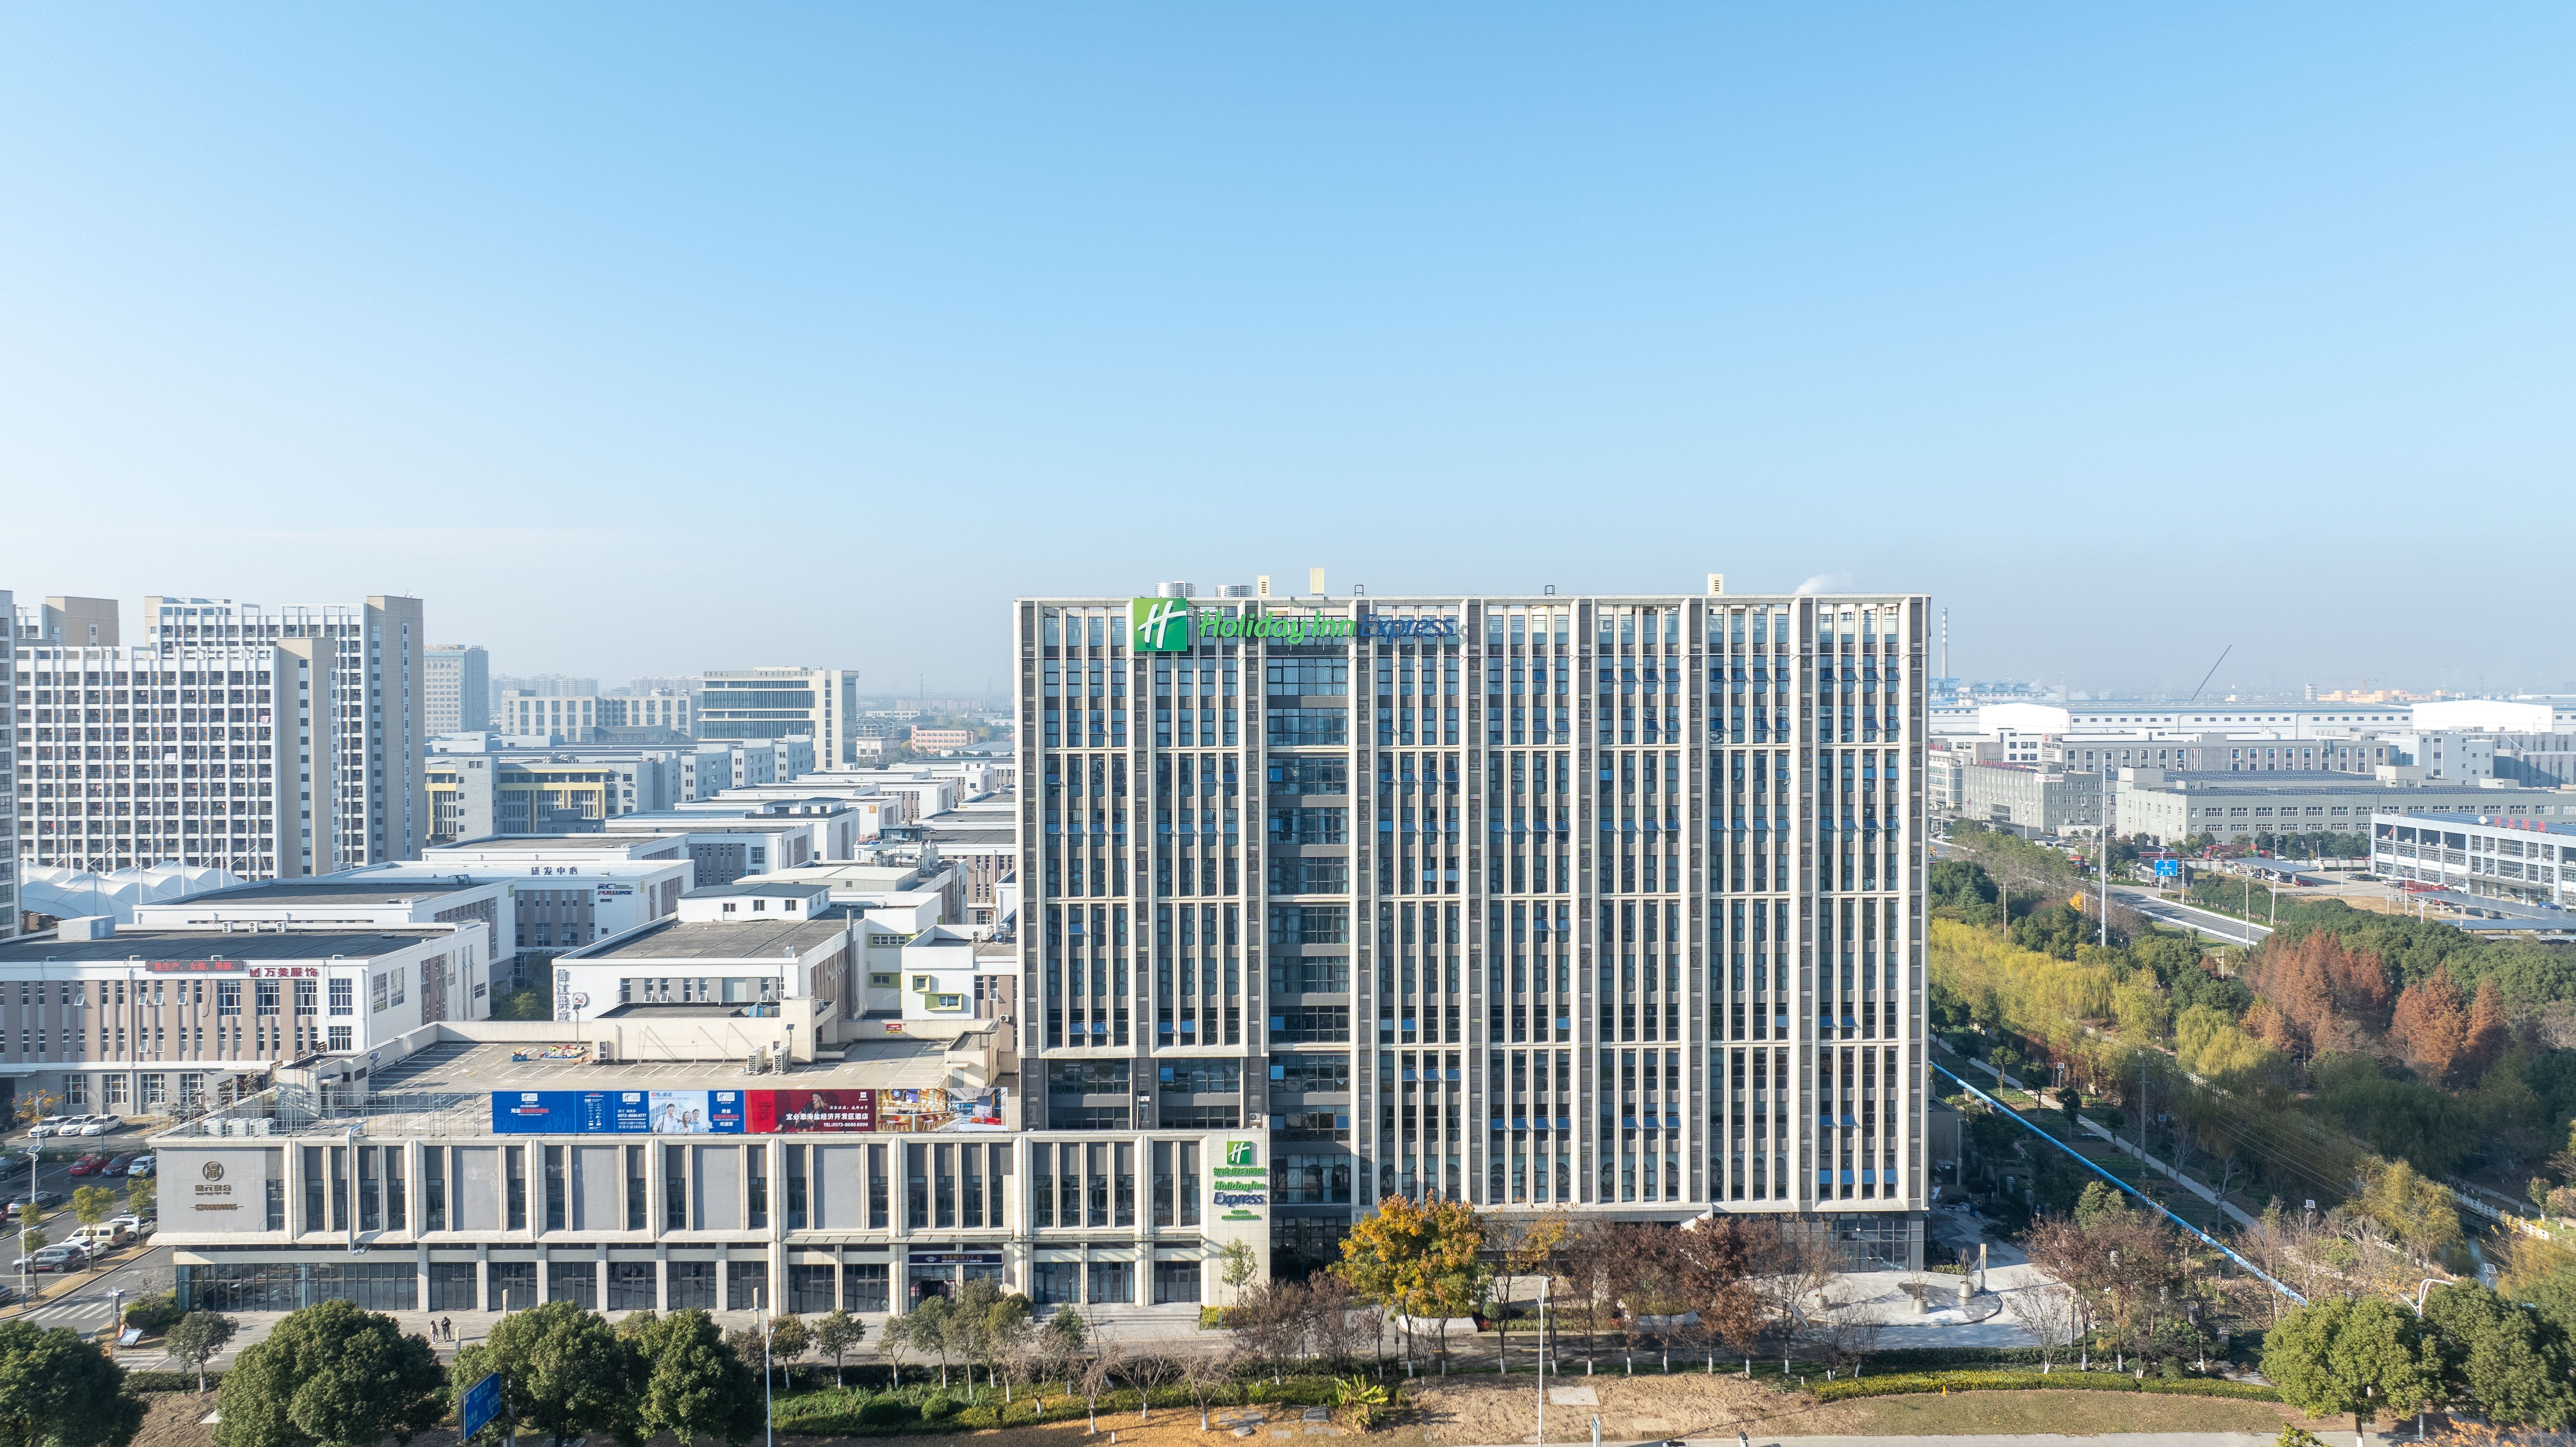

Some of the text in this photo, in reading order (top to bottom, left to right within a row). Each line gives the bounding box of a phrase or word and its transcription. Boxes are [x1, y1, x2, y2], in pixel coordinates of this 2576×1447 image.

[1198, 610, 1455, 644] Holiday Inn Express
[531, 866, 578, 875] 研发中心
[264, 967, 318, 977] 万美服饰
[1213, 1167, 1266, 1176] 智选假日酒店
[1213, 1180, 1265, 1191] Holiday Inn
[1213, 1192, 1264, 1207] Express
